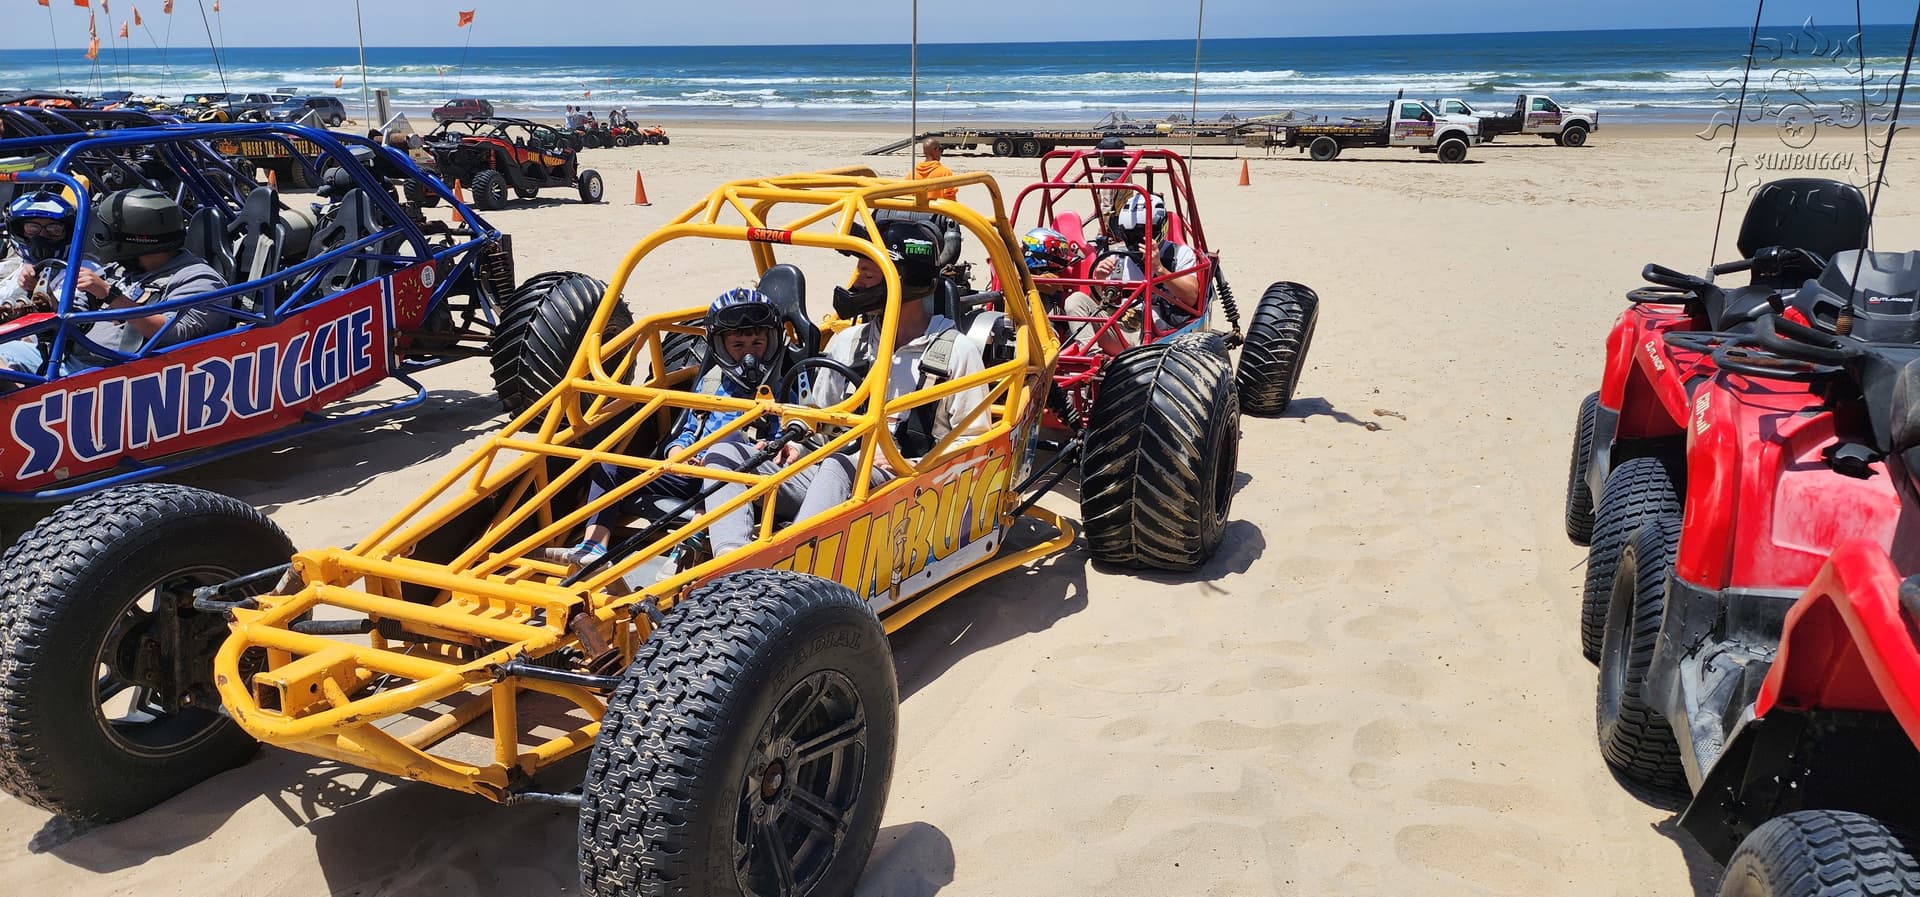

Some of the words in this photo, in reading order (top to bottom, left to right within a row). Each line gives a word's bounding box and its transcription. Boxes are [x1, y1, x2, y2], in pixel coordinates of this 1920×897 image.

[241, 140, 263, 156] WHERE
[264, 140, 276, 155] THE
[527, 152, 539, 162] SUN
[11, 305, 374, 480] SUNBUGGIE
